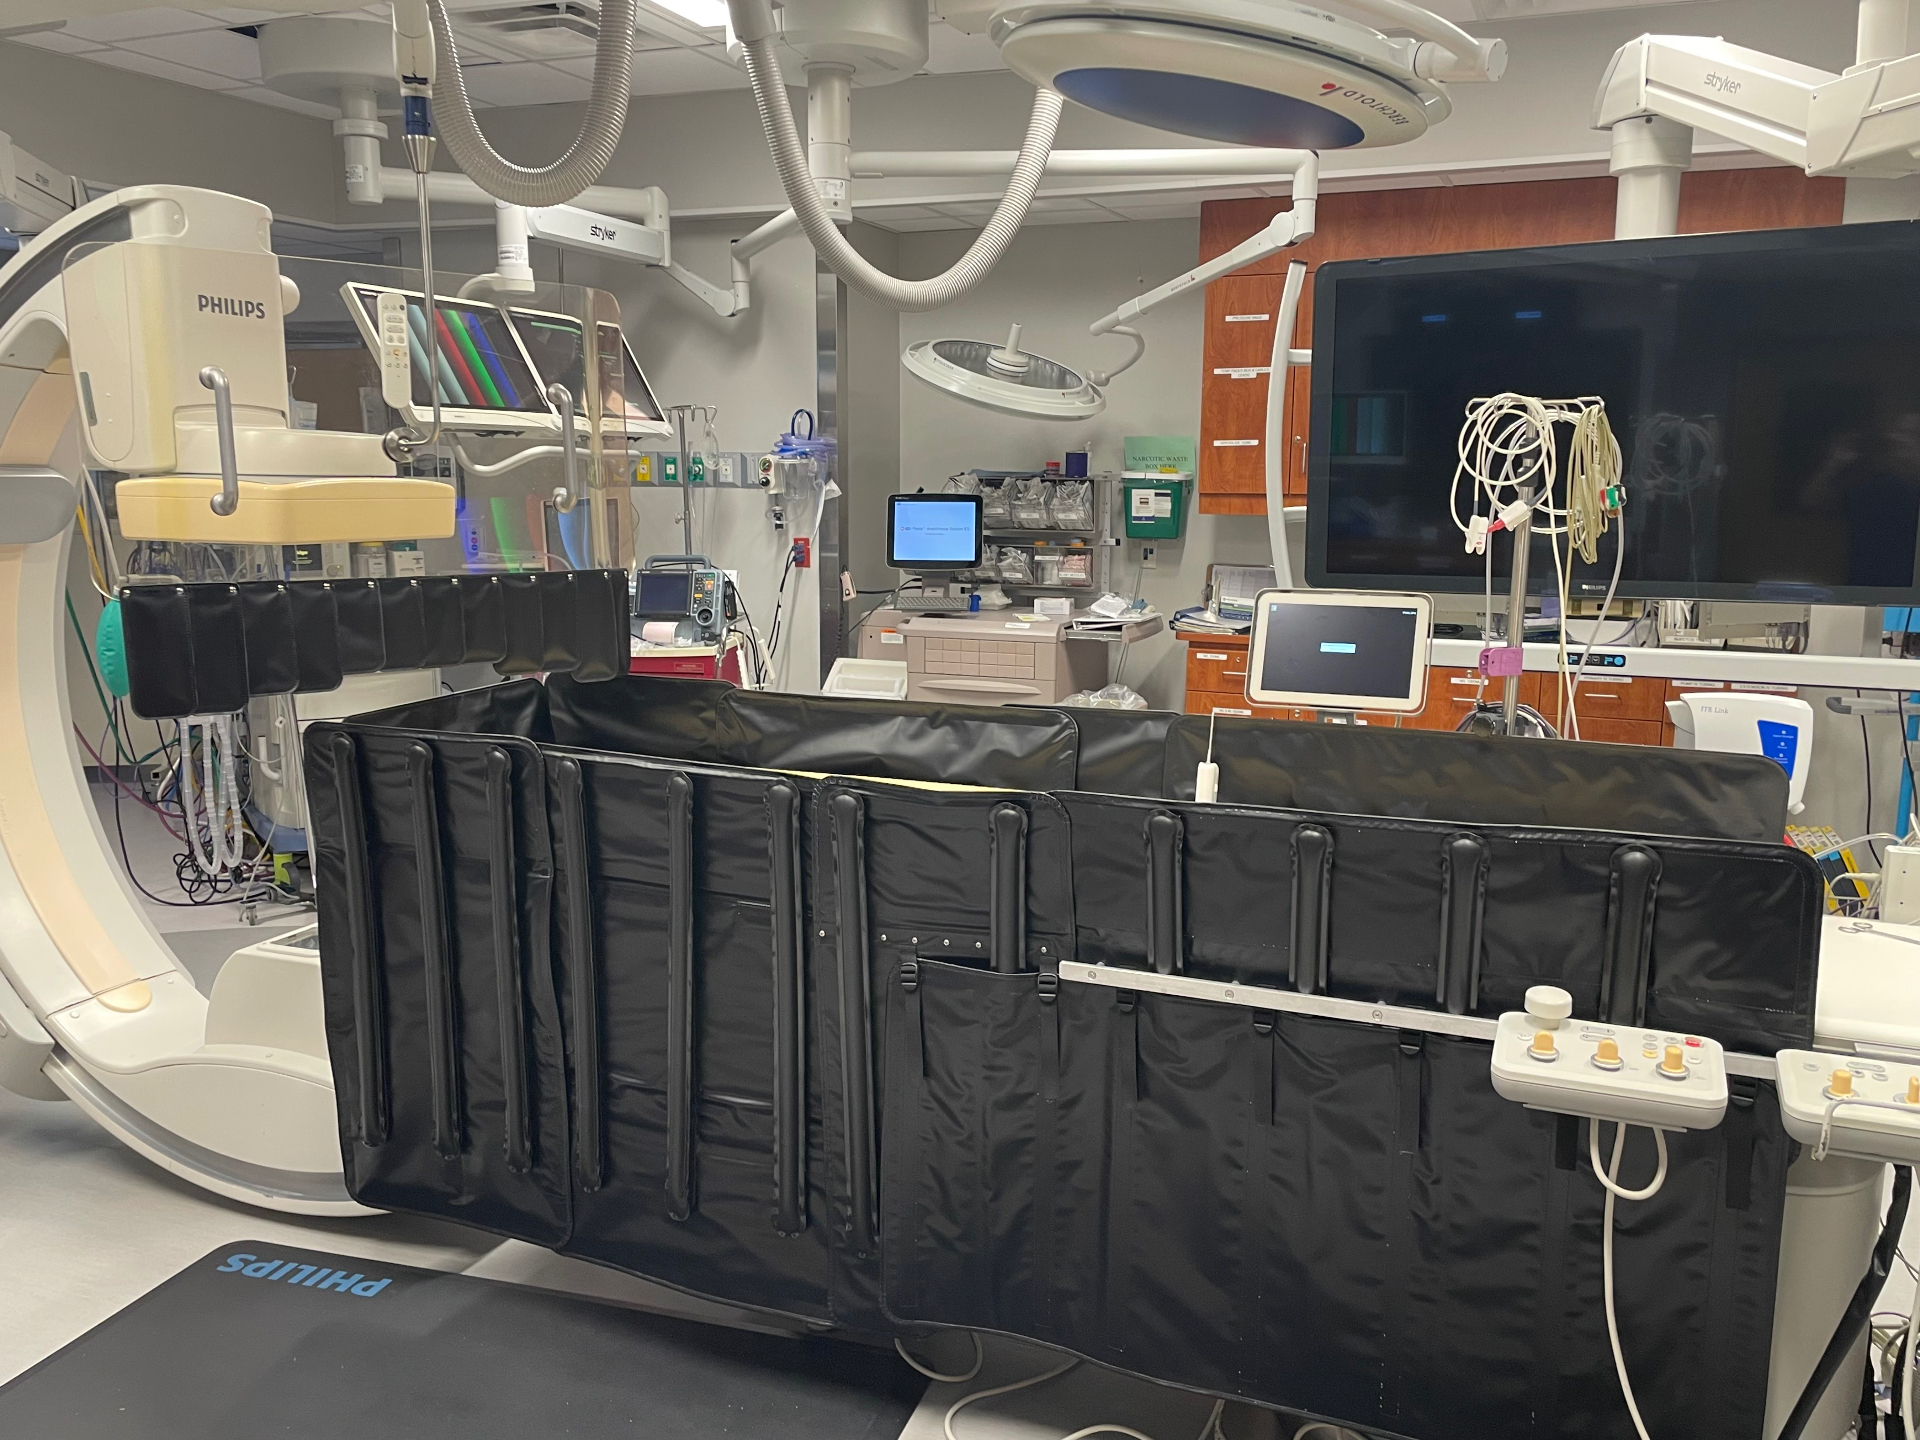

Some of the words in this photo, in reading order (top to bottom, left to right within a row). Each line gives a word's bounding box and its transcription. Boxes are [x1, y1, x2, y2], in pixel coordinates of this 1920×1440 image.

[1703, 71, 1742, 95] stryker
[1343, 90, 1410, 125] BERCHTOLD
[590, 223, 617, 241] stryker
[197, 294, 266, 320] PHILIPS
[1700, 705, 1713, 713] FFR
[216, 1253, 393, 1298] PHILIPS
